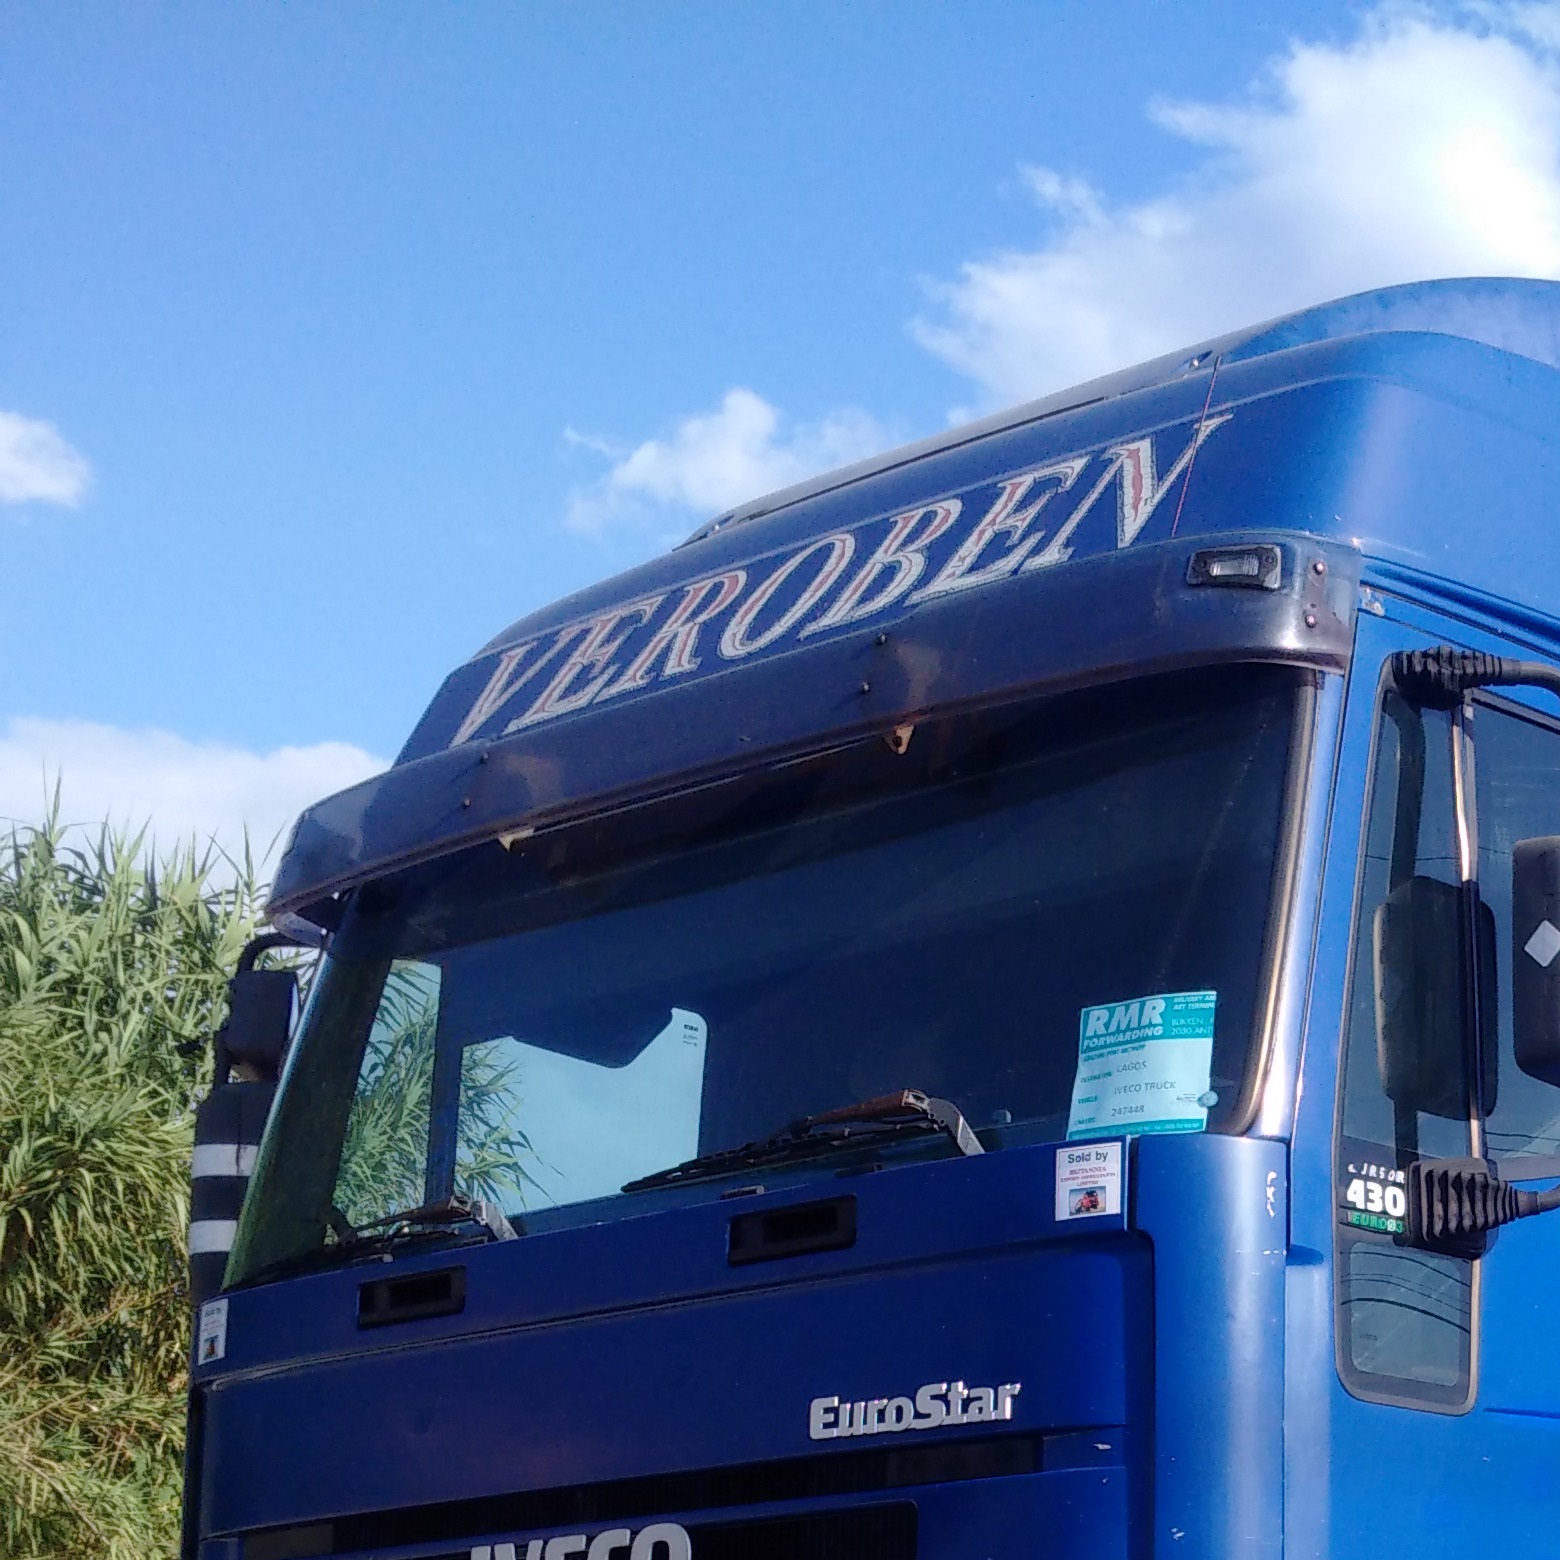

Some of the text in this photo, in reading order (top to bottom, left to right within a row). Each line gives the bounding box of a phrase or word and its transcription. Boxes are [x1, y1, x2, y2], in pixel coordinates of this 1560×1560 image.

[449, 412, 1234, 749] VEROBEN
[1085, 999, 1166, 1037] RMR
[1082, 1026, 1164, 1050] FORWARDING
[1117, 1060, 1147, 1073] LAGOS
[1114, 1081, 1176, 1095] IVECO TRUCK
[1067, 1150, 1109, 1164] Sold by
[1346, 1179, 1406, 1217] 430
[808, 1380, 1022, 1441] EuroStar
